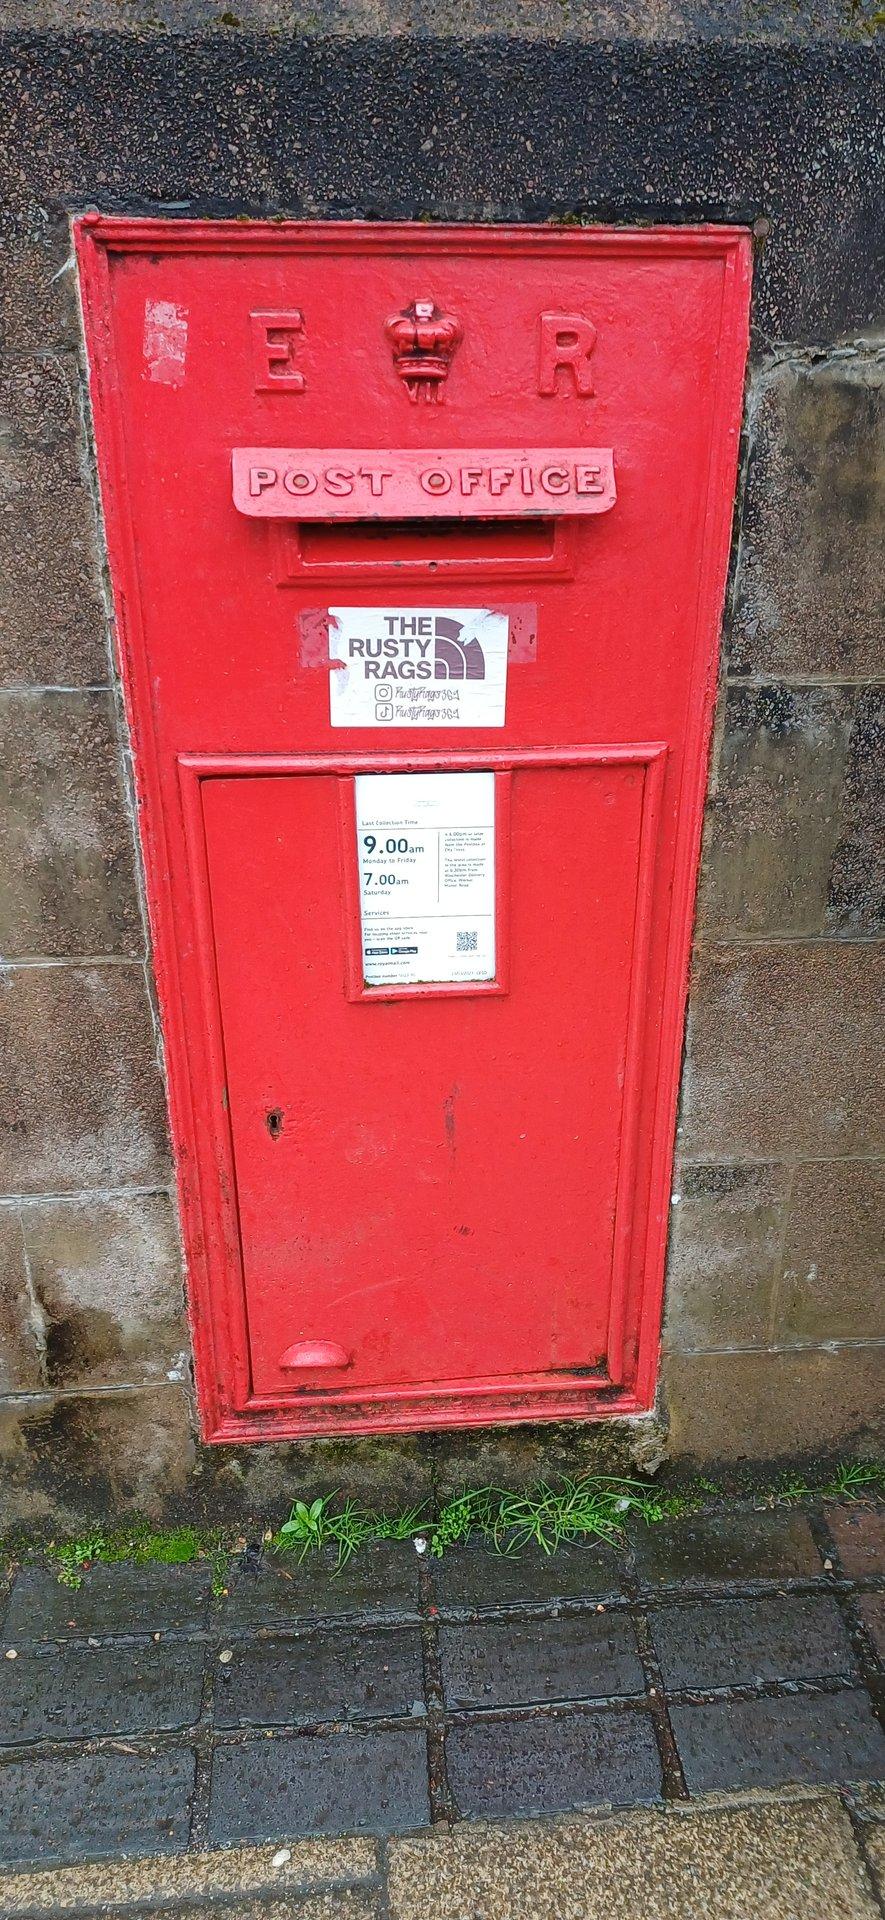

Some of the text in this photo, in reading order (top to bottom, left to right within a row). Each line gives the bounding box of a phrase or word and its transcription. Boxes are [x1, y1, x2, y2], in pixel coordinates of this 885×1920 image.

[249, 308, 306, 394] E
[537, 310, 597, 395] R
[249, 465, 605, 497] POST OFFICE
[383, 616, 432, 635] THE
[349, 638, 432, 657] RUSTY
[364, 661, 432, 680] RAGS
[363, 835, 424, 855] 9.00am
[363, 873, 409, 886] 7.00am
